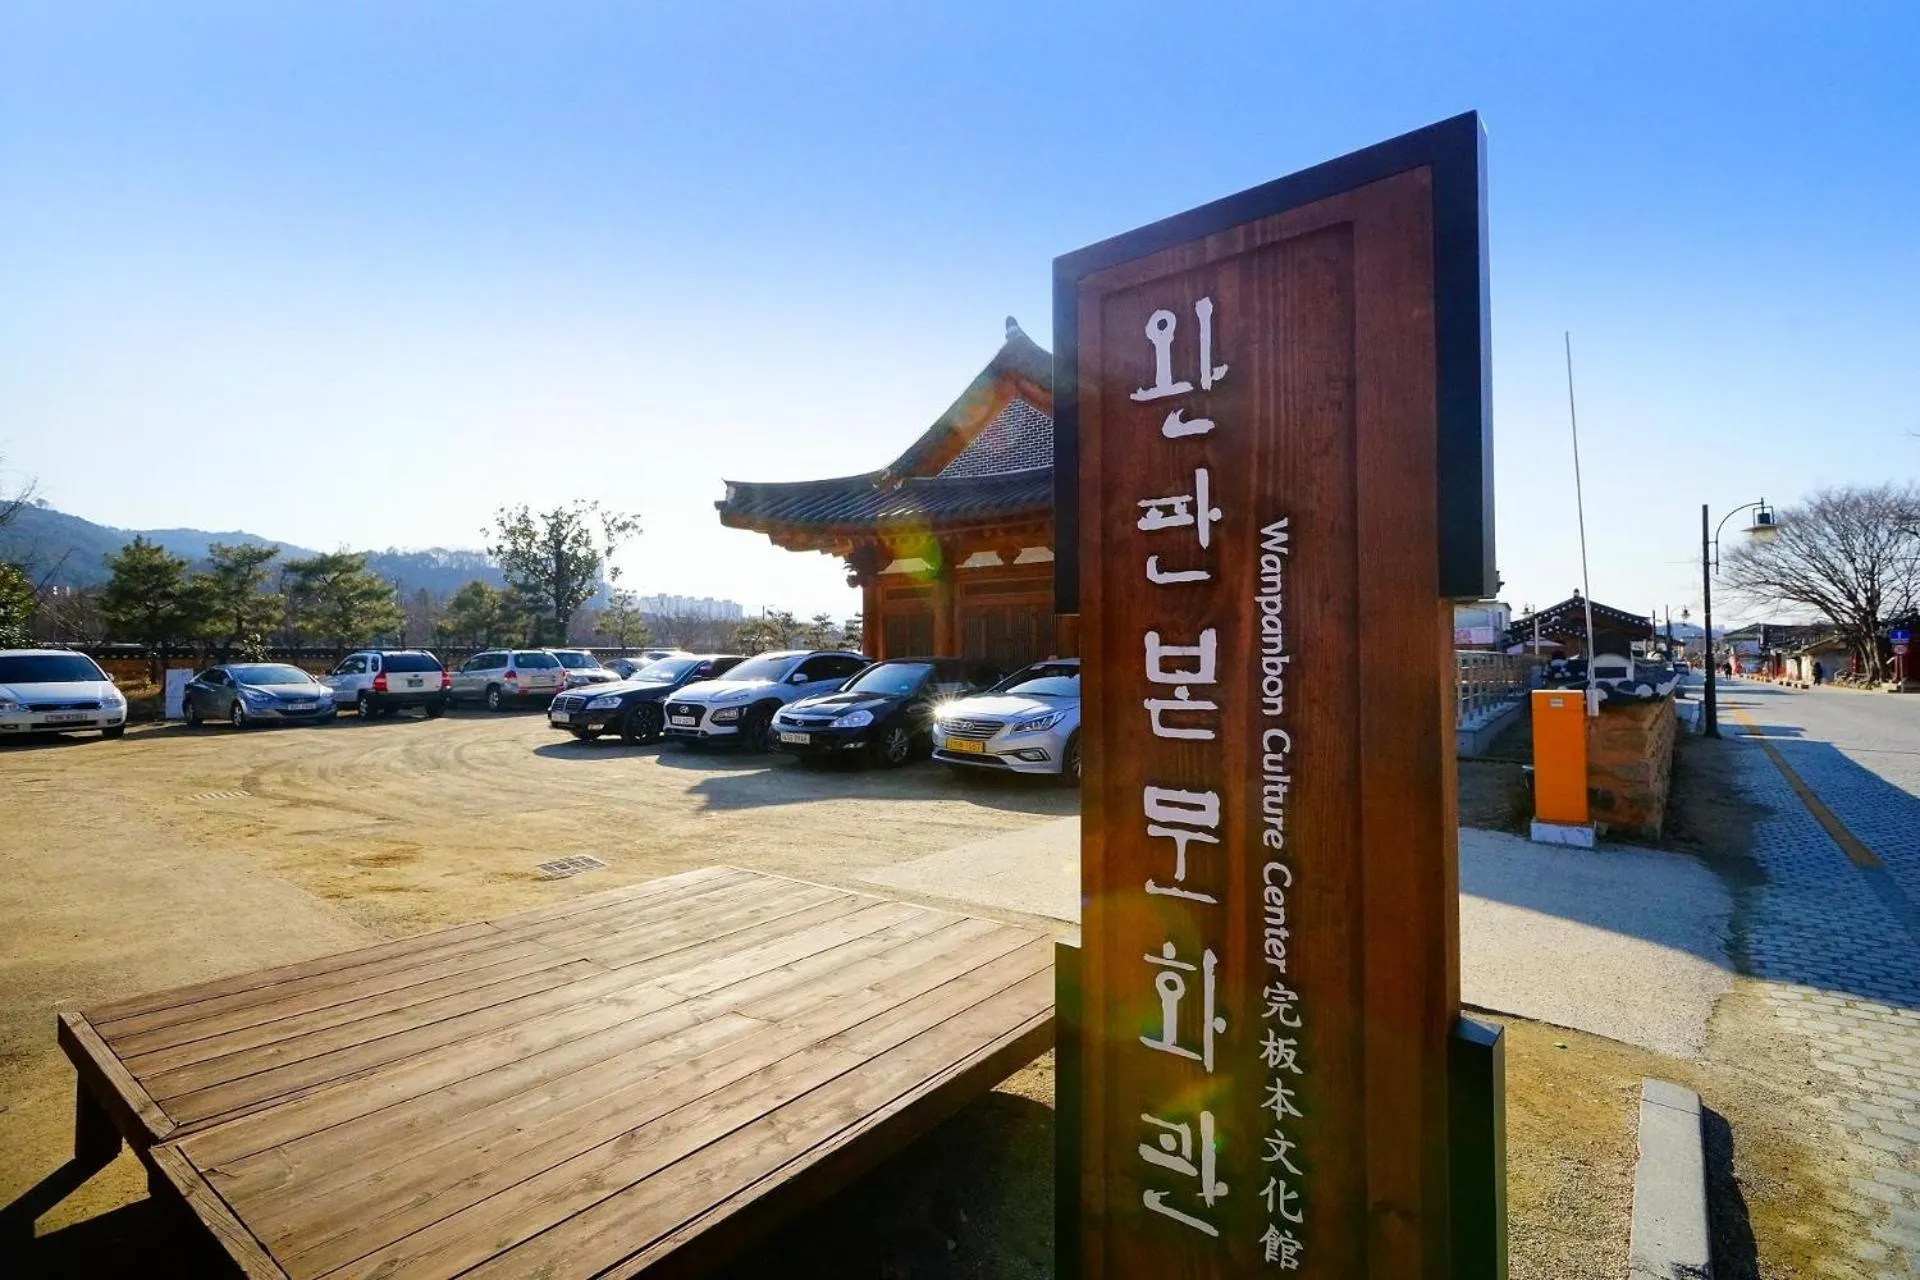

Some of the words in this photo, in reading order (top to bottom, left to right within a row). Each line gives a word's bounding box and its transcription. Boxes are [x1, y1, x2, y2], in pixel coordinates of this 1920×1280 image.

[1255, 517, 1290, 716] Wanpanbon
[1130, 297, 1229, 1237] 완판본문화관
[1262, 728, 1291, 849] Culture
[1263, 861, 1292, 974] Center
[1259, 982, 1303, 1270] 完板本文化館
